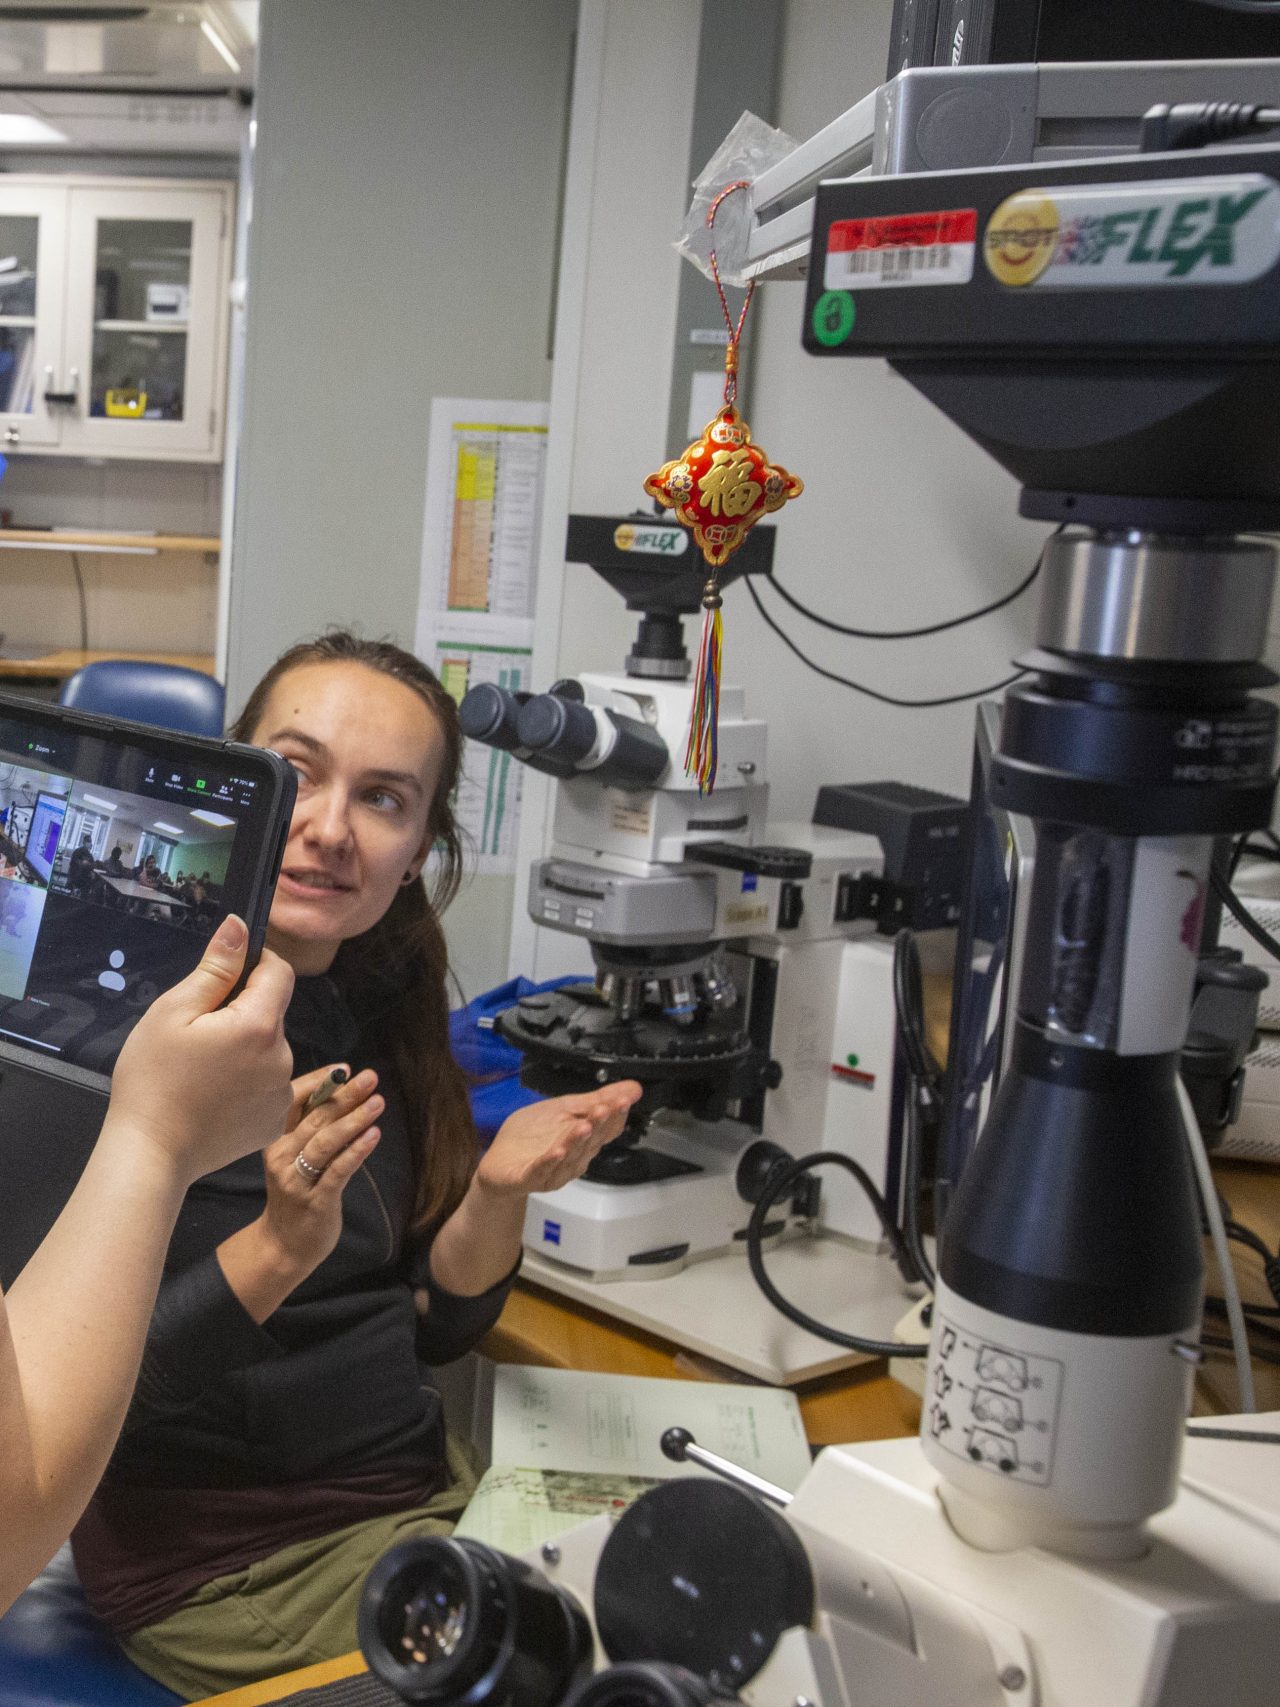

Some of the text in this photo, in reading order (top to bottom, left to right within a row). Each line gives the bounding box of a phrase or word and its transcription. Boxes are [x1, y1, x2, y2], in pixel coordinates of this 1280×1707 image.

[1094, 188, 1271, 277] FLEX
[698, 449, 762, 518] 福
[644, 532, 682, 551] FLEX
[35, 744, 50, 753] Zoom
